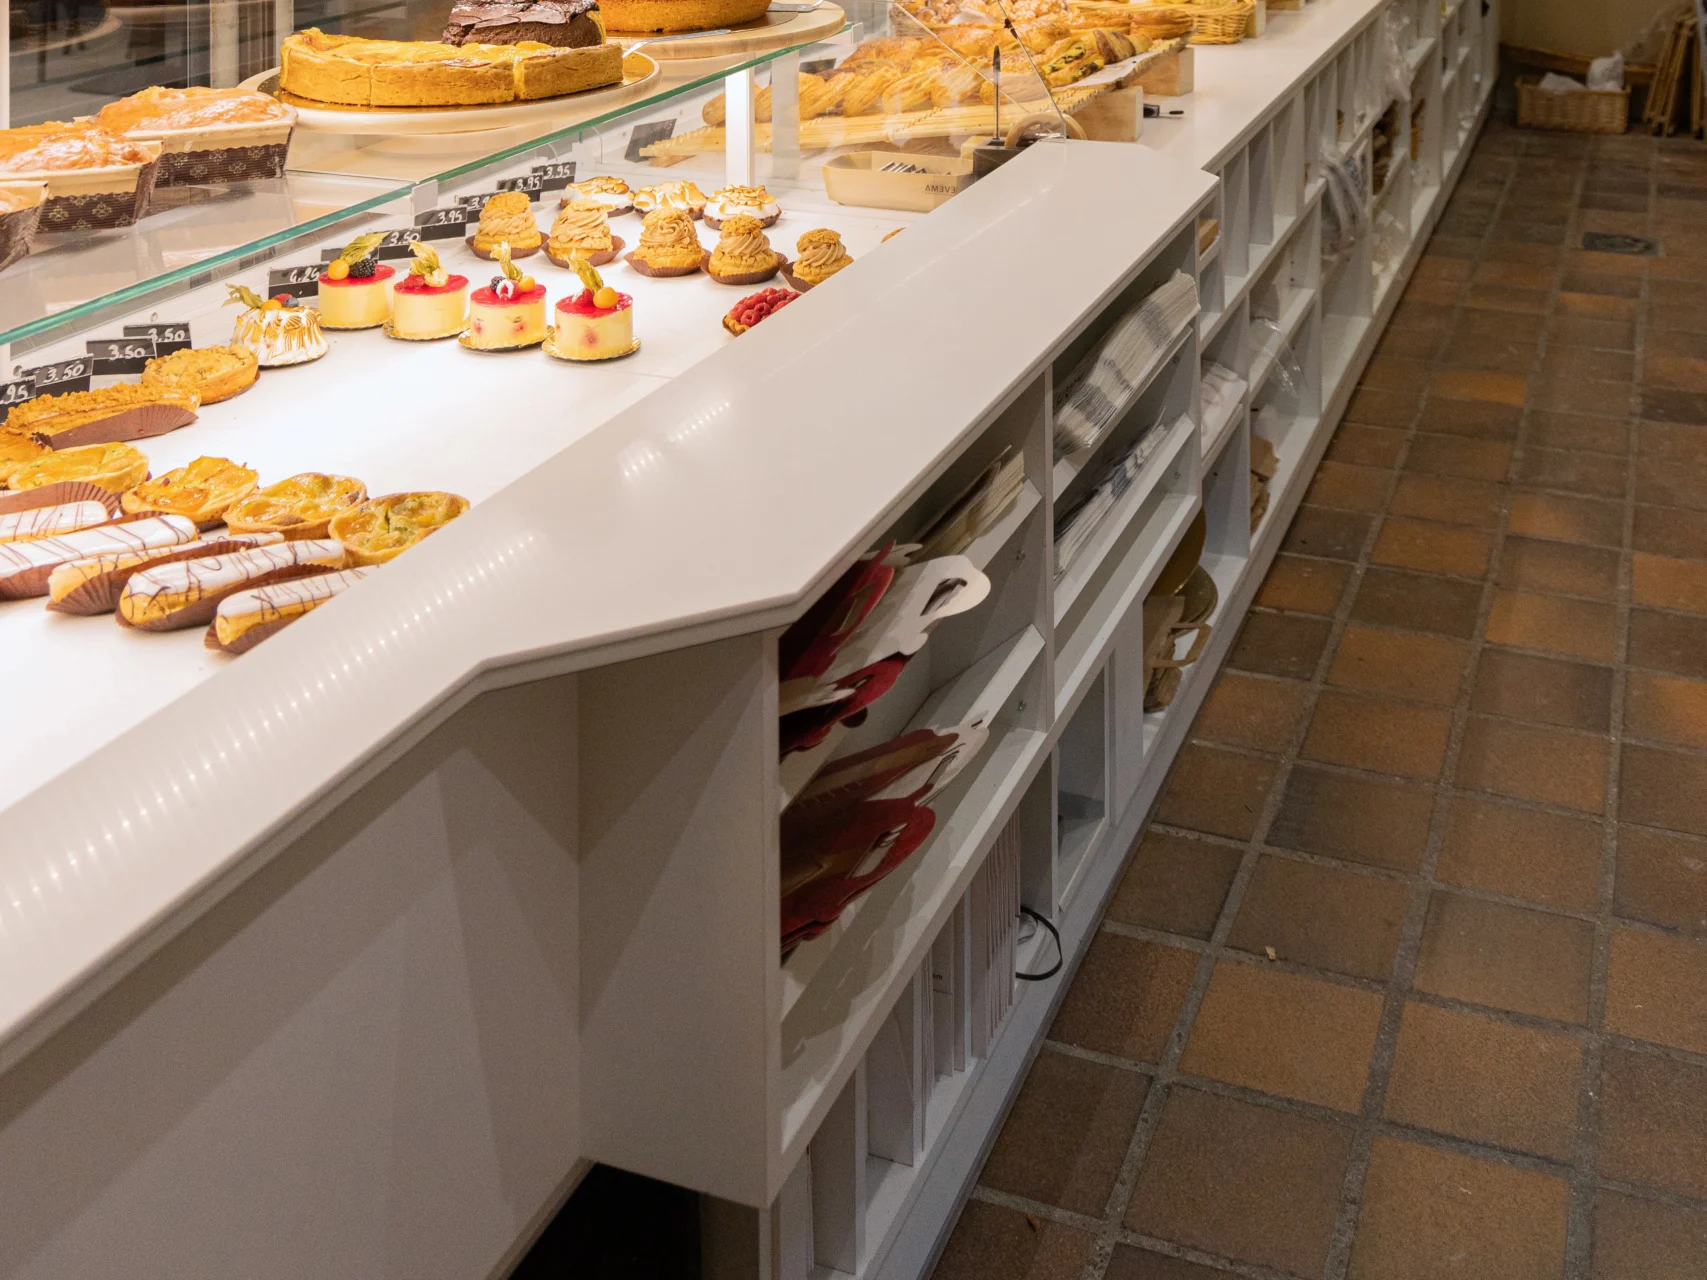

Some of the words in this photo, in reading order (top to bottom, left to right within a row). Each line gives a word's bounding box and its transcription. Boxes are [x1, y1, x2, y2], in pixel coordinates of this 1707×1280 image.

[543, 165, 570, 179] 3.95
[515, 176, 540, 191] 3.95
[467, 195, 491, 209] 3.9
[436, 210, 463, 224] 3.95
[389, 231, 420, 246] 3.50
[148, 328, 186, 342] 3.50
[108, 344, 146, 360] 3.50
[43, 363, 84, 384] 3.50
